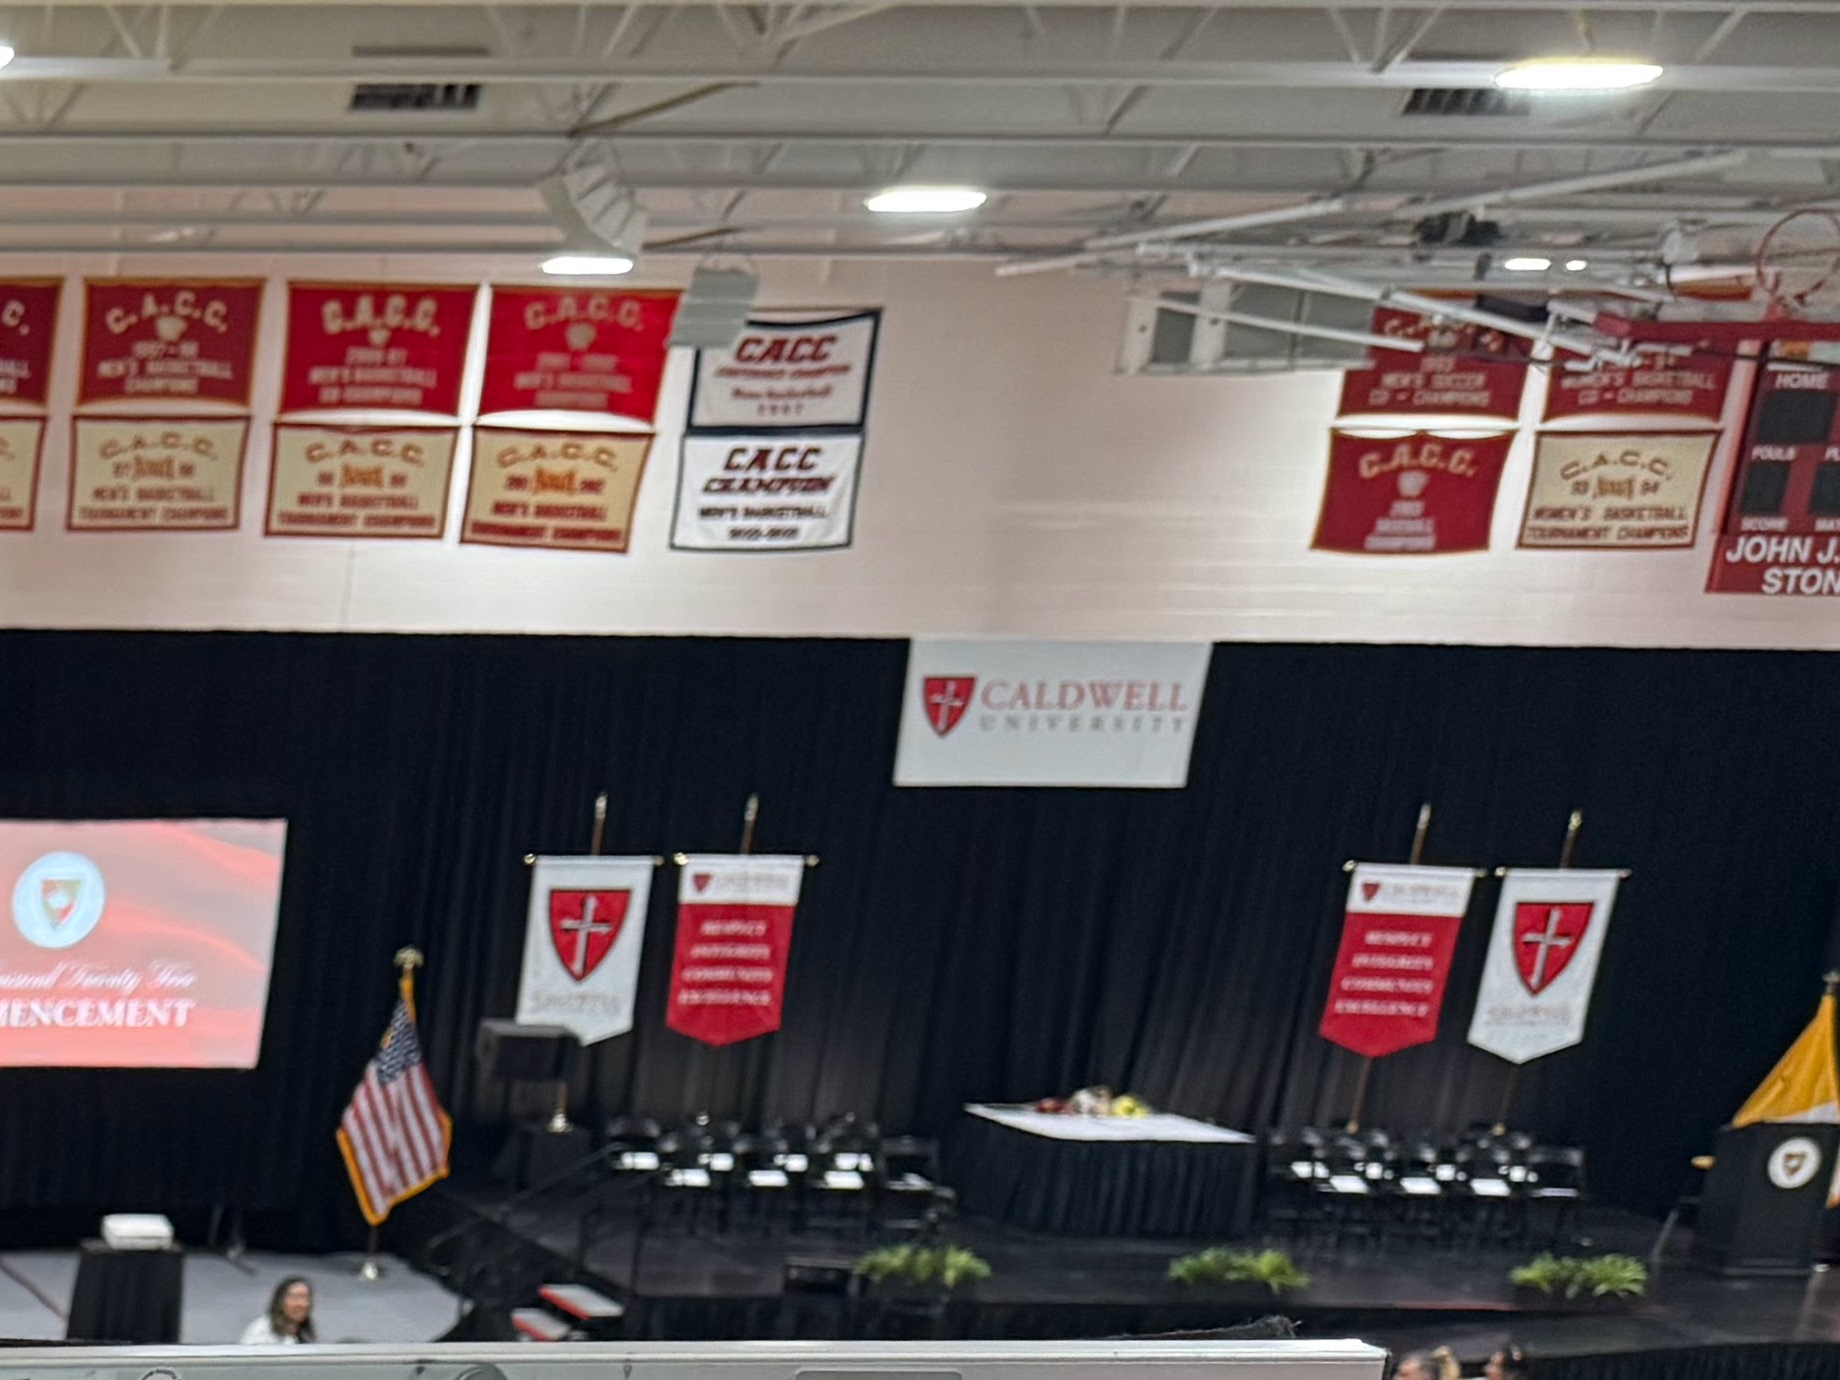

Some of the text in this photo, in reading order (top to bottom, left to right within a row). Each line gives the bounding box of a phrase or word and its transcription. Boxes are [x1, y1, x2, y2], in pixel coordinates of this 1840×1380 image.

[735, 335, 837, 363] CACC
[1776, 373, 1830, 389] HOME
[724, 448, 822, 471] CACC
[1603, 507, 1688, 520] BASKETBALL
[1726, 537, 1812, 563] JOHN
[980, 679, 1188, 712] CALDWELL
[978, 715, 1185, 733] UNIVERSITY
[64, 960, 142, 995] Twenty
